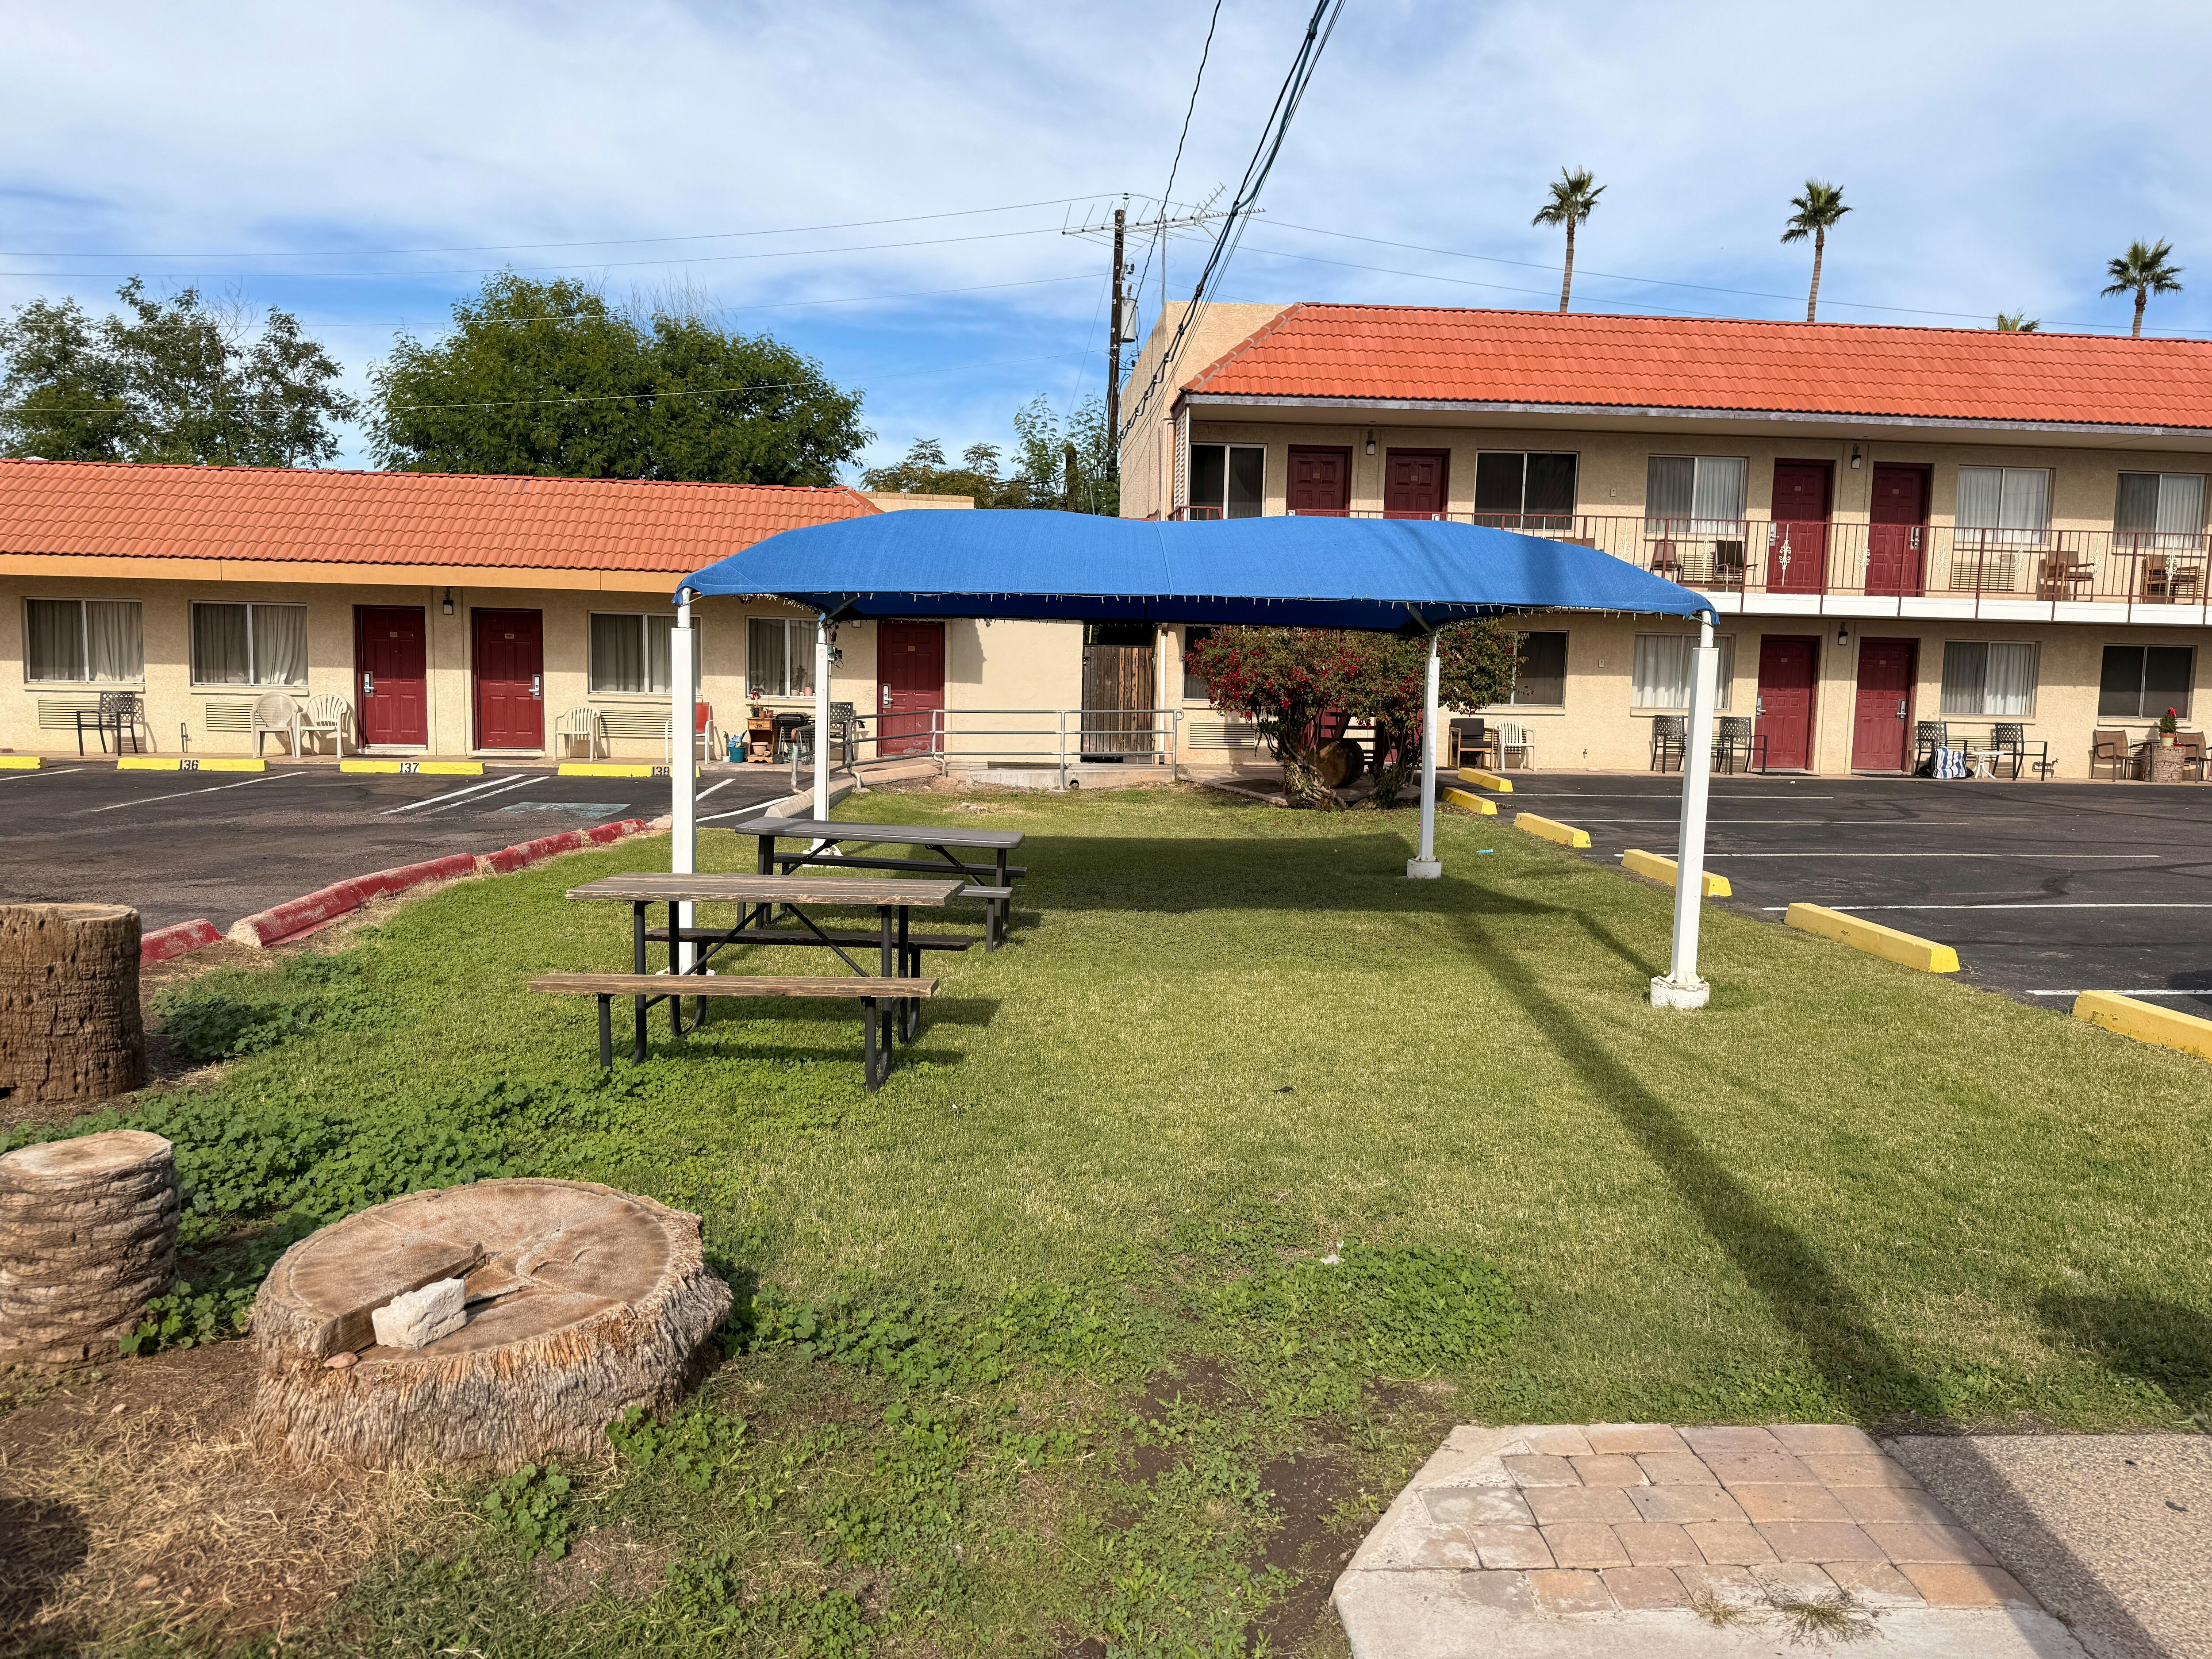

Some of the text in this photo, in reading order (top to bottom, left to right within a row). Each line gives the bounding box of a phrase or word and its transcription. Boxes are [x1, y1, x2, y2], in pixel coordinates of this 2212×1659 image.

[180, 759, 199, 770] 136
[399, 762, 419, 772] 137
[652, 766, 670, 776] 138
